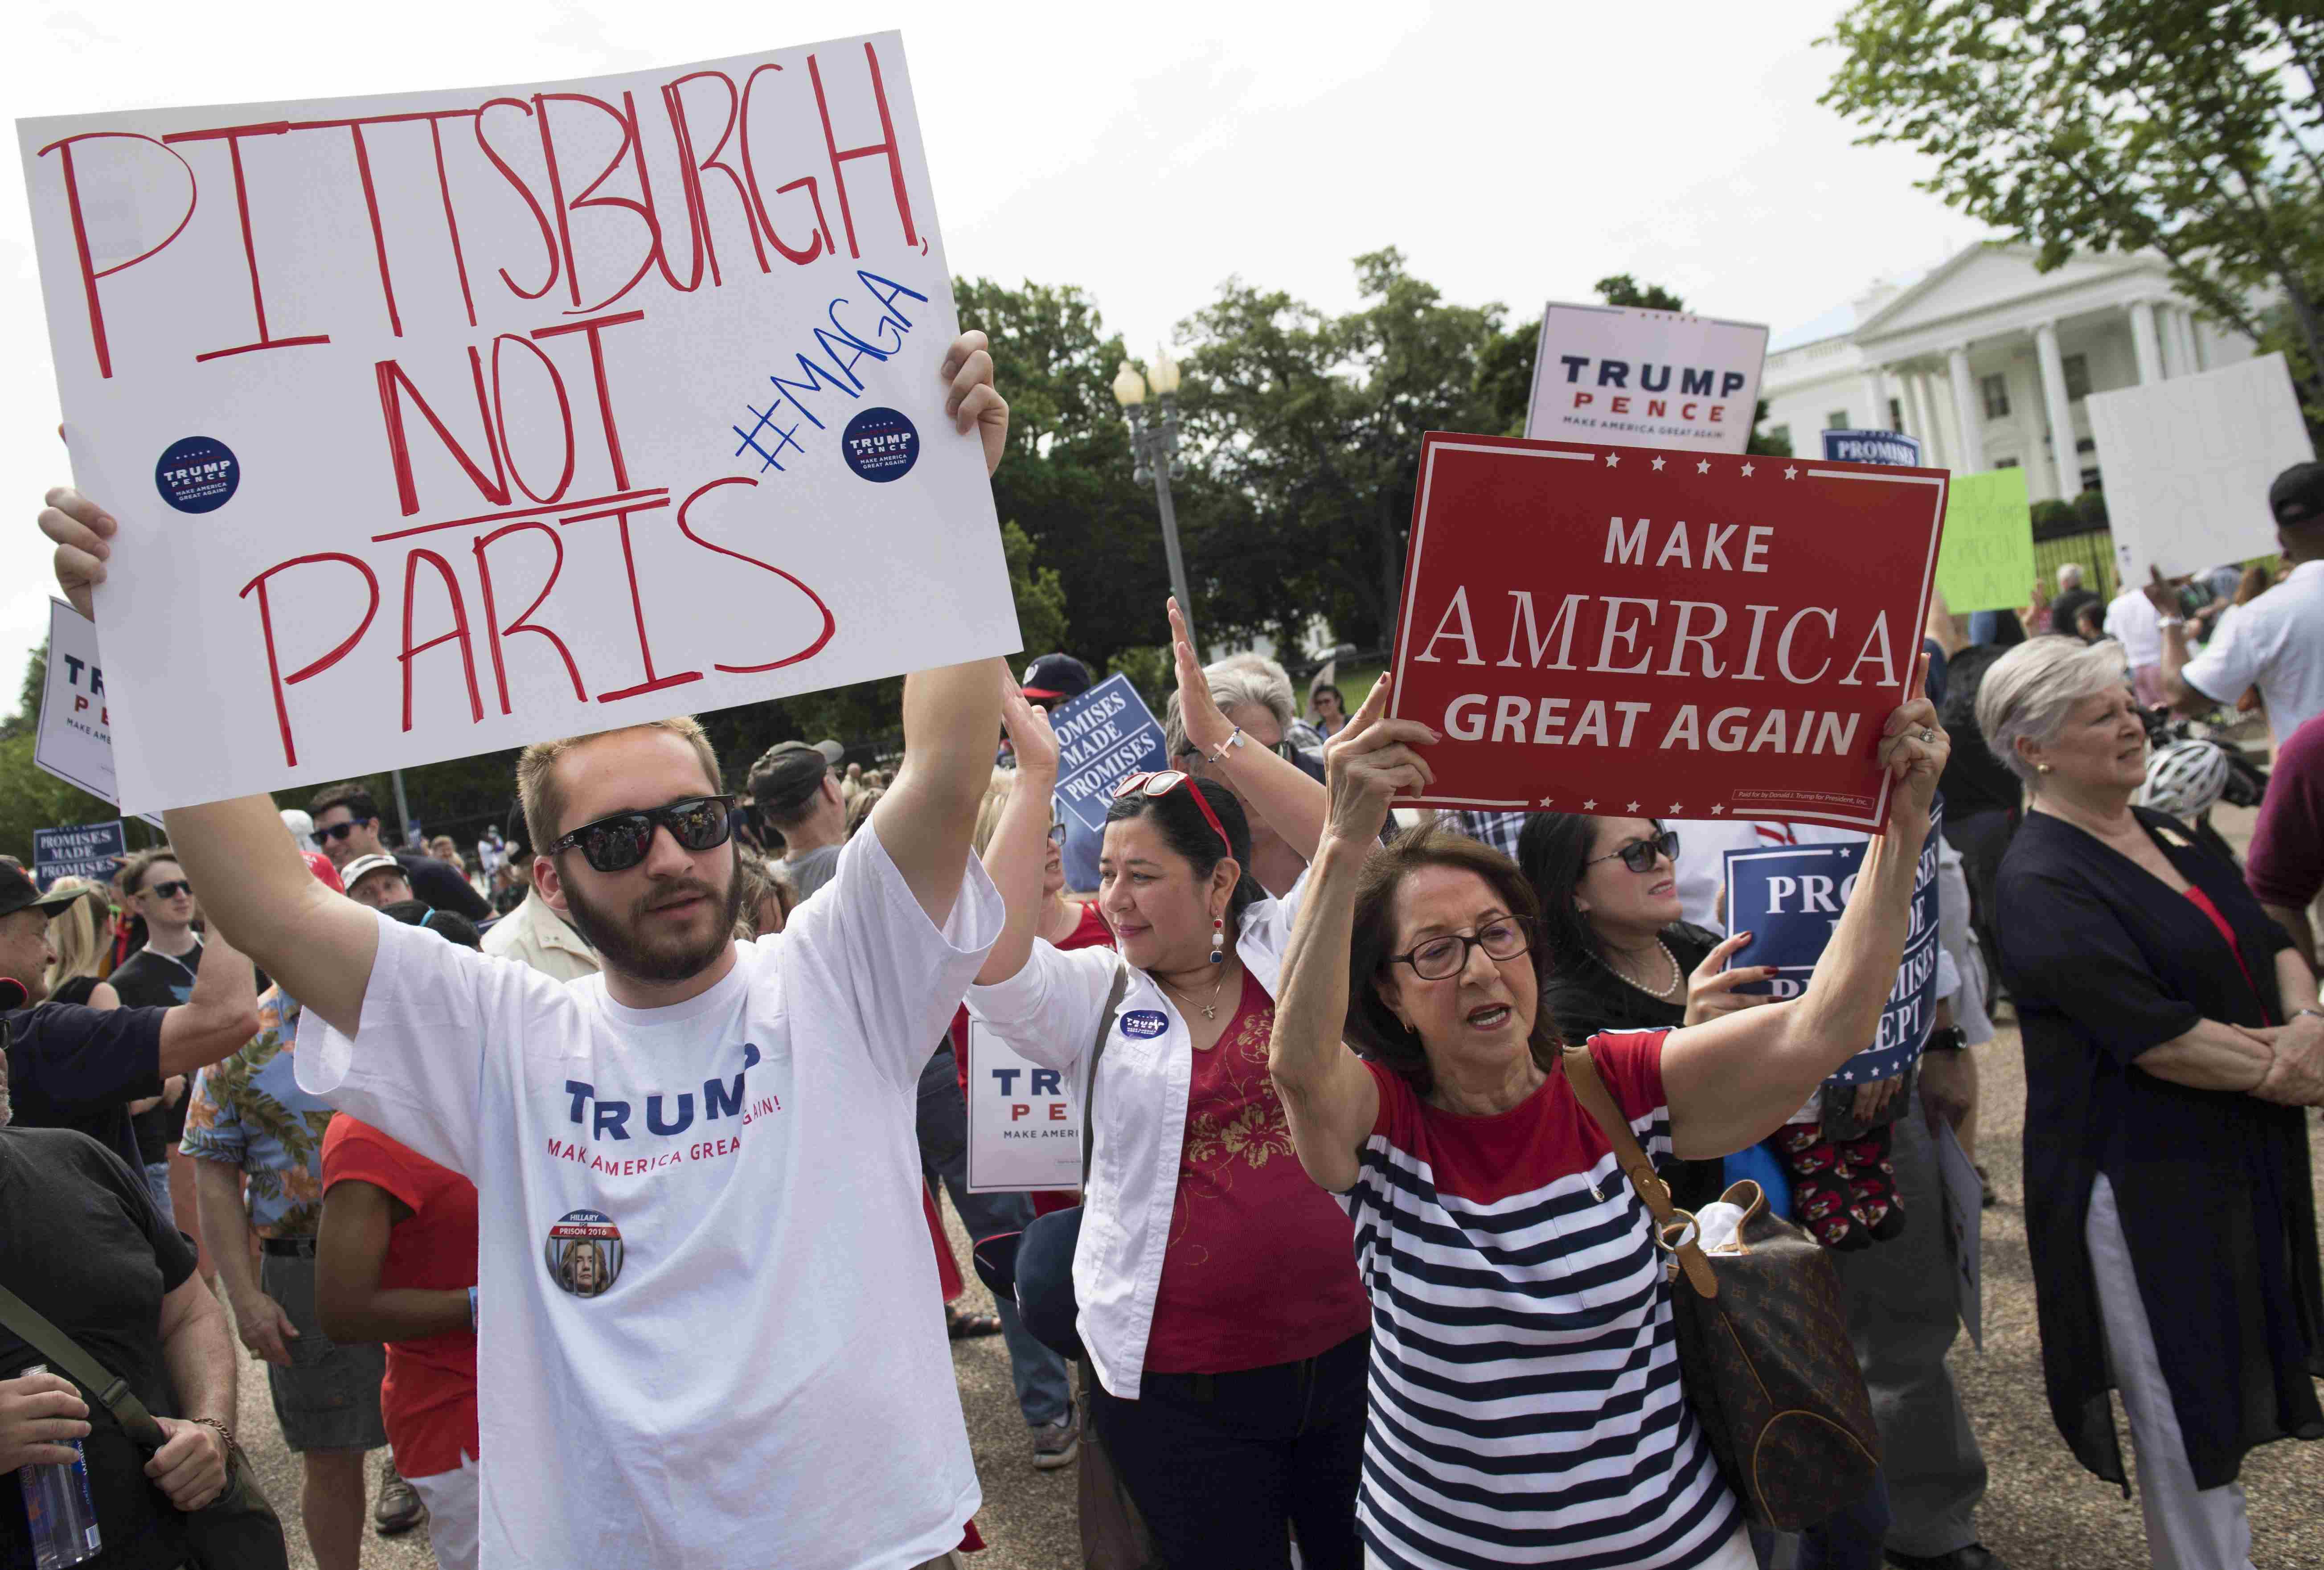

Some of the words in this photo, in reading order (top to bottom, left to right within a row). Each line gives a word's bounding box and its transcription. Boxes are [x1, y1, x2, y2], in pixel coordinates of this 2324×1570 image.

[37, 41, 928, 379] PITTSBURGH,
[733, 270, 928, 473] #MAGA
[1561, 355, 1745, 398] TRUMP
[375, 310, 644, 516] NOT
[1574, 392, 1725, 422] PENCE
[850, 433, 911, 449] TRUMP
[1563, 415, 1597, 427] MAKE
[1601, 421, 1656, 435] AMERICA
[1659, 426, 1692, 436] GREAT
[857, 443, 907, 455] PENCE
[879, 454, 907, 462] AMERICA
[164, 460, 231, 481] TRUMP
[171, 471, 227, 488] PENCE
[176, 488, 196, 496] MAKE
[197, 482, 228, 492] AMERICA
[179, 492, 201, 501] GREAT
[1603, 516, 1774, 573] MAKE
[239, 476, 836, 767] PARIS
[1414, 584, 1901, 687] AMERICA
[64, 653, 105, 699] TR
[66, 717, 91, 735] MAKE
[93, 730, 111, 745] AME
[1055, 691, 1127, 746] OMISES
[1443, 693, 1652, 749] GREAT
[1659, 705, 1861, 756] AGAIN
[1061, 720, 1123, 769] MADE
[1065, 732, 1156, 802] PROMISES
[41, 830, 111, 849] PROMISES
[51, 845, 95, 859] MADE
[41, 859, 115, 878] PROMISES
[1765, 873, 1858, 914] PR
[1890, 937, 1935, 1004] MISES
[1873, 994, 1922, 1051] EPT
[992, 1068, 1062, 1096] TR
[1012, 1103, 1067, 1121] PE
[548, 1137, 587, 1164] MAK
[590, 1151, 681, 1176] AMERICA
[690, 1136, 741, 1161] GREA
[742, 1095, 781, 1126] GAIN!
[1004, 1131, 1037, 1139] MAKE
[1041, 1129, 1079, 1138] AMERI
